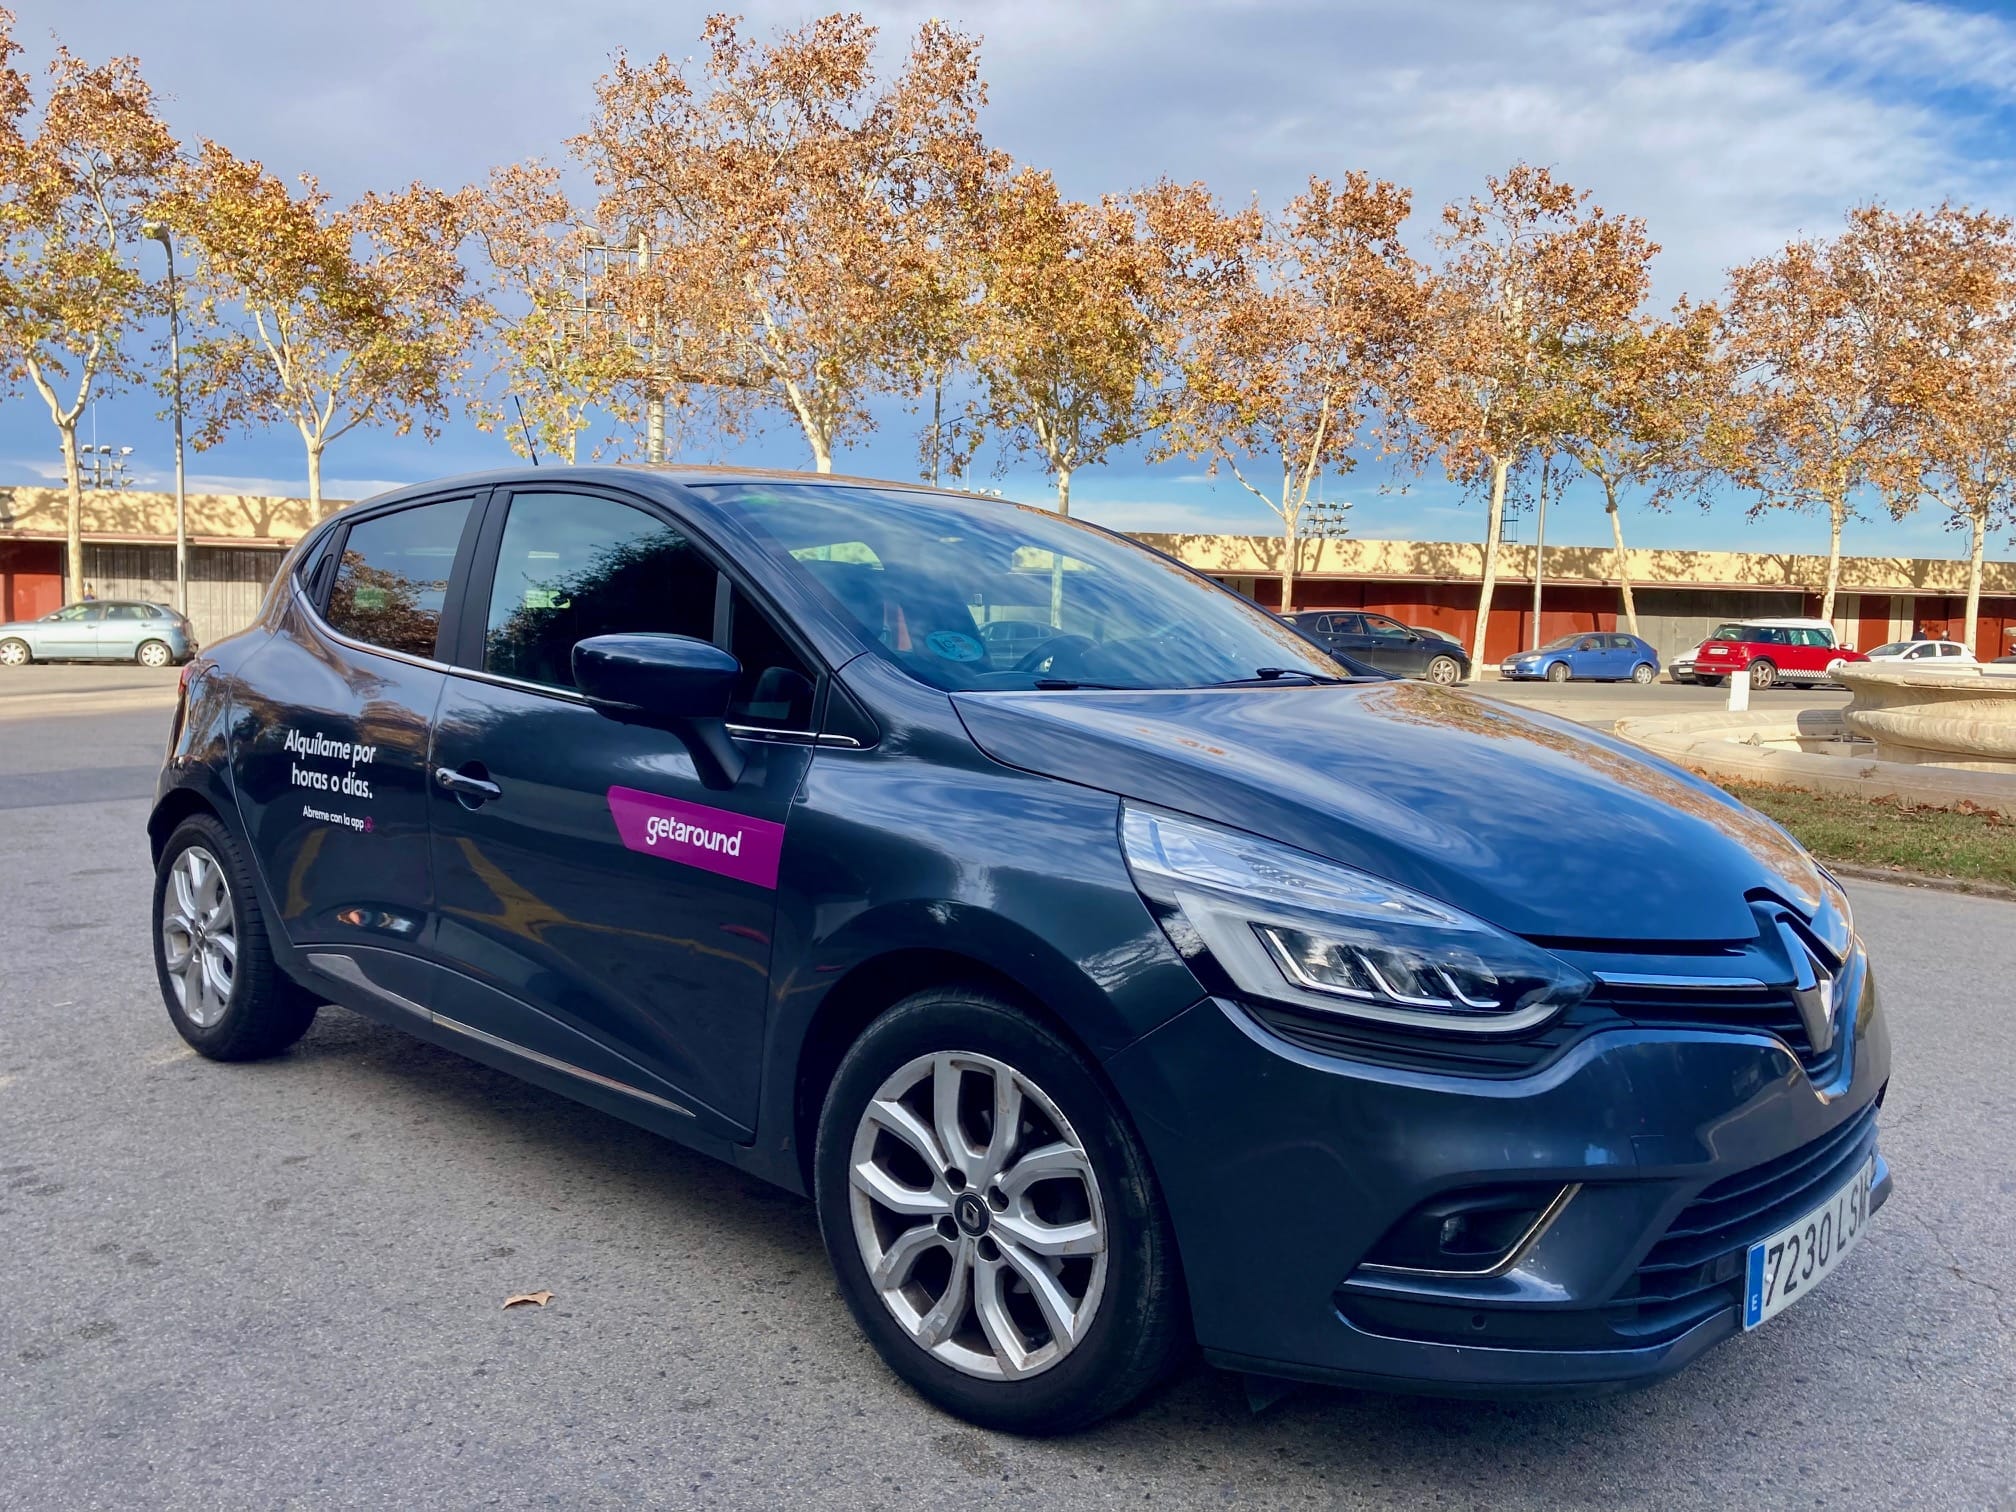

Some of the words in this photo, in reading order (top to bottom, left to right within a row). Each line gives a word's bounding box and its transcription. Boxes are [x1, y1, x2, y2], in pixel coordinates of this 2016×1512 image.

[284, 729, 350, 760] Alquílame
[352, 745, 376, 768] por
[292, 762, 328, 790] horas
[331, 776, 339, 792] o
[342, 771, 373, 799] días.
[330, 813, 343, 824] con
[343, 813, 350, 826] la
[351, 817, 364, 832] app
[646, 816, 742, 856] getaround
[1766, 1211, 1831, 1307] 7230
[1751, 1293, 1759, 1312] E
